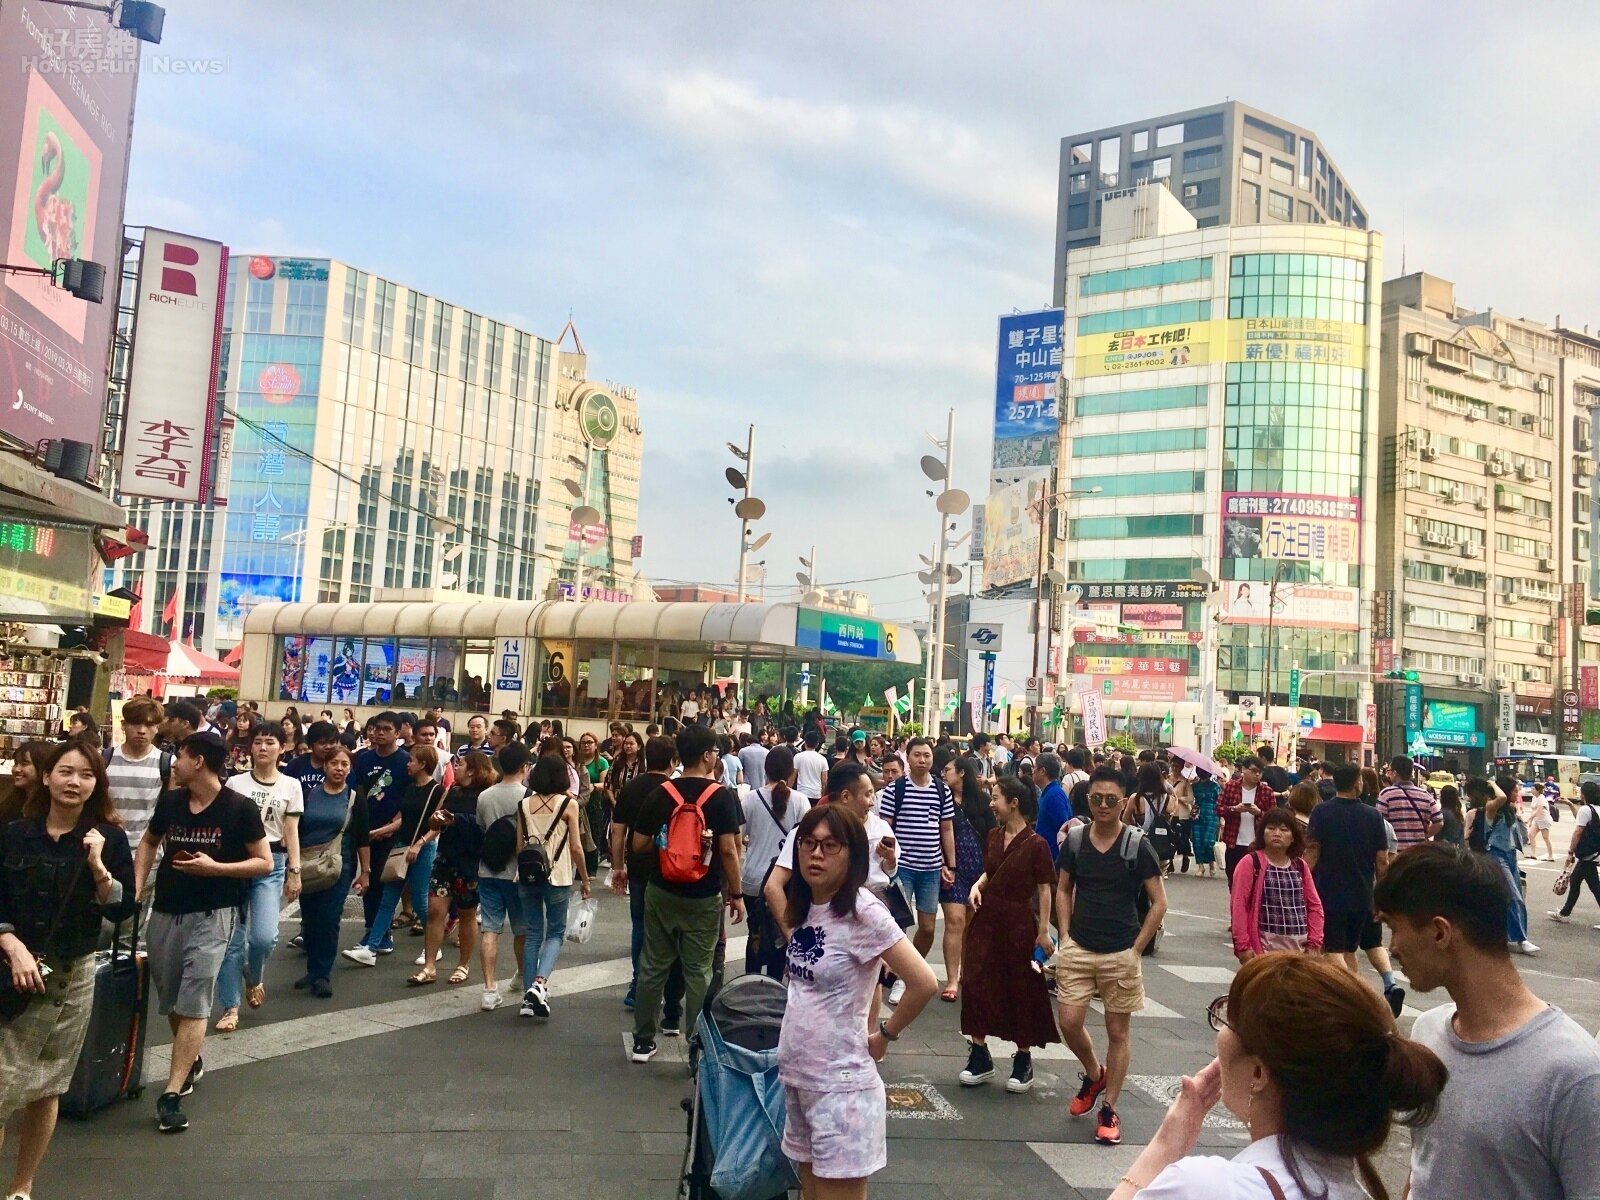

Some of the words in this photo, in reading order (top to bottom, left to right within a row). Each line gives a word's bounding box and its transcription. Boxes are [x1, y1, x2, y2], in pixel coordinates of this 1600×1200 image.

[68, 68, 100, 122] TEENAGE
[100, 110, 115, 142] RIOT
[149, 293, 209, 312] RICHELITE
[1108, 328, 1191, 352] 去日本工作吧!
[1111, 358, 1165, 370] 02-2361-9002
[23, 401, 38, 416] SONY
[38, 410, 55, 425] MUSIC
[839, 624, 864, 640] 西門站
[886, 633, 894, 653] 6
[549, 652, 565, 682] 6
[506, 681, 520, 689] 20m
[1016, 715, 1023, 730] 1
